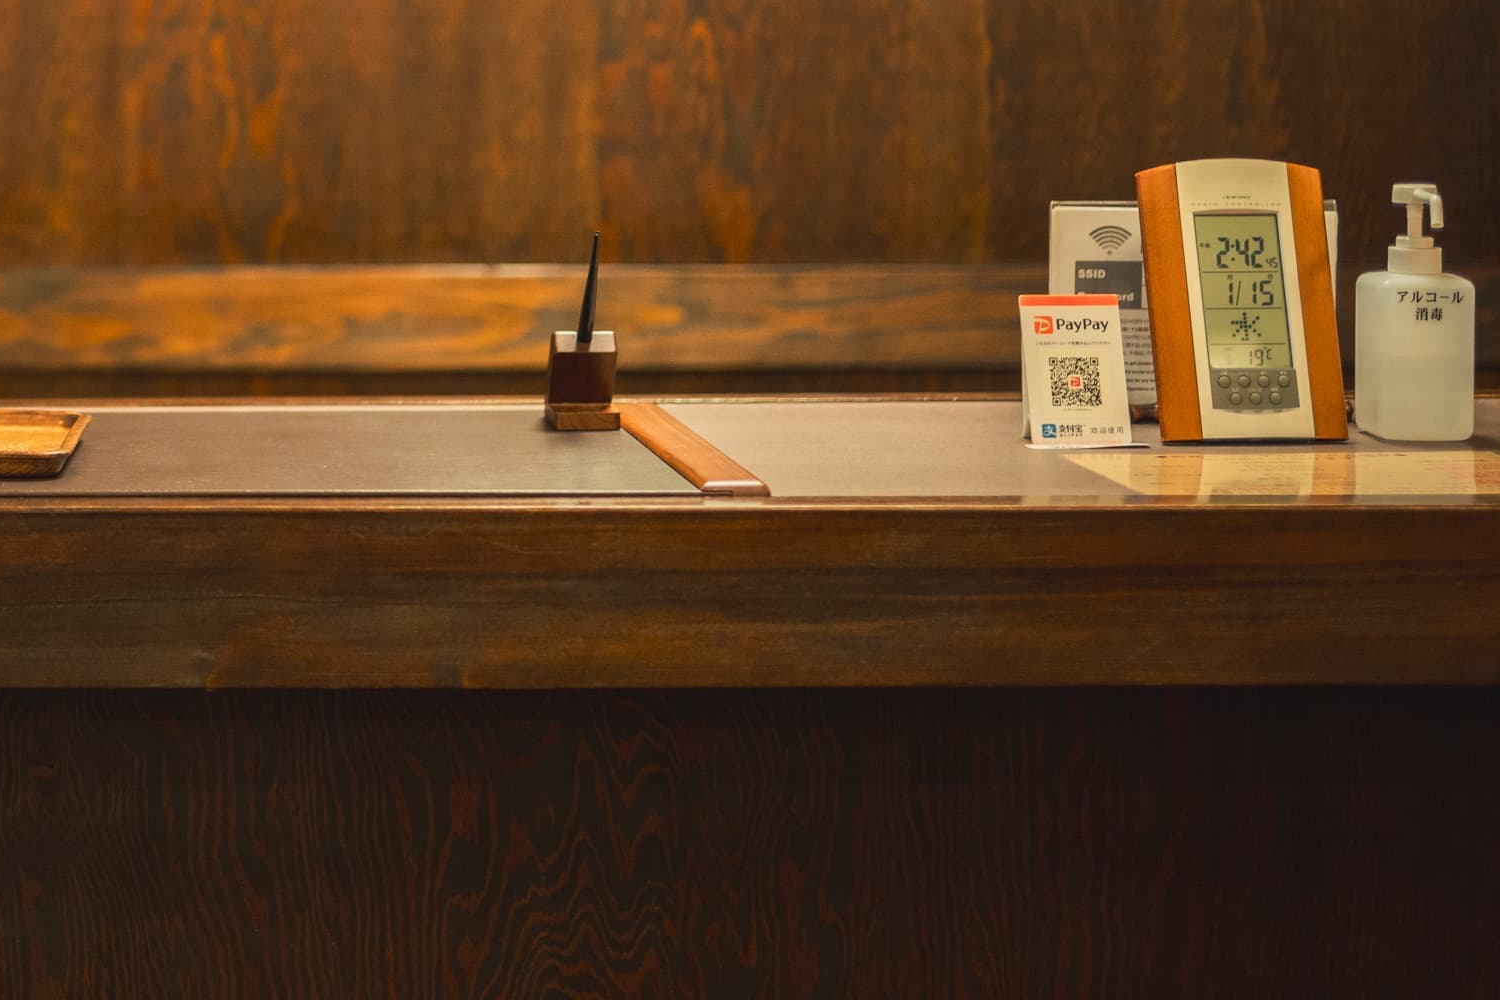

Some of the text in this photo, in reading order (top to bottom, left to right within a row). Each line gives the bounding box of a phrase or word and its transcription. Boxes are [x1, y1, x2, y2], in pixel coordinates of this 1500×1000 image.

[1216, 236, 1264, 268] 2:42
[1078, 268, 1106, 279] SSID
[1397, 291, 1464, 303] アルコール
[1415, 308, 1443, 320] 消毒
[1056, 318, 1109, 332] PayPay
[1230, 312, 1262, 341] 水
